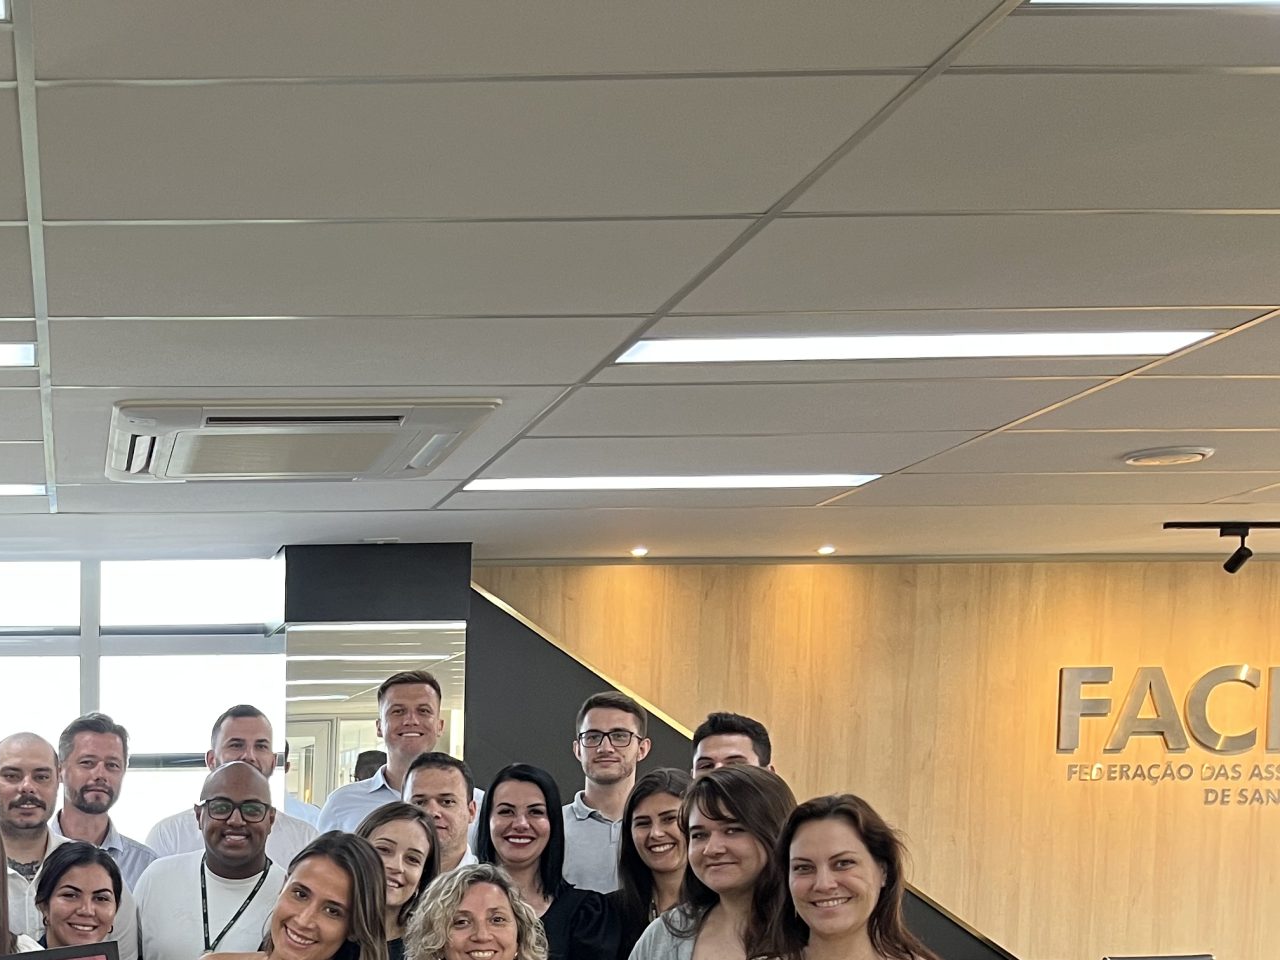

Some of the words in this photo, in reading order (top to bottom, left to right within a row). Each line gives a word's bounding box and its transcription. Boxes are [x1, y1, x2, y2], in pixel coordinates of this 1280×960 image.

[1067, 761, 1194, 785] FEDERAÇÃO
[1200, 763, 1242, 781] DAS
[1204, 788, 1231, 805] DE
